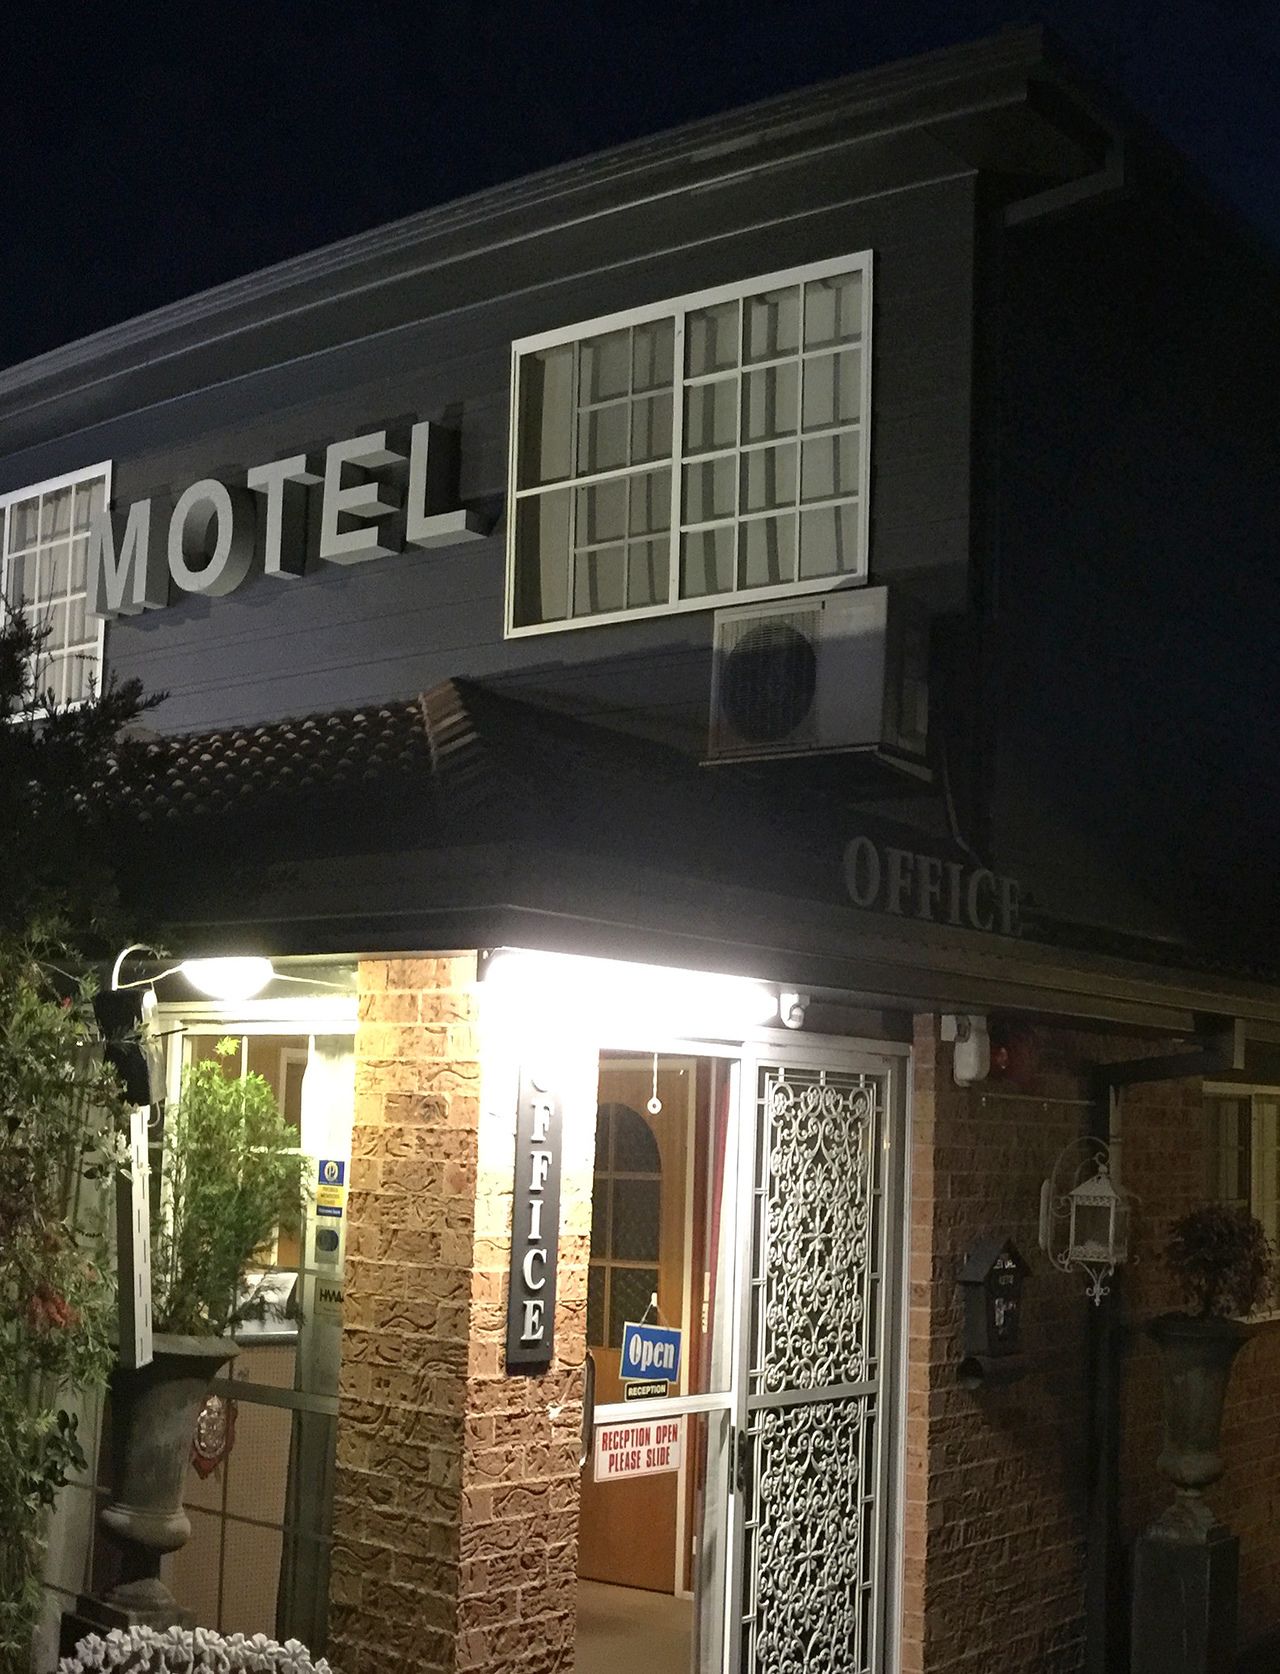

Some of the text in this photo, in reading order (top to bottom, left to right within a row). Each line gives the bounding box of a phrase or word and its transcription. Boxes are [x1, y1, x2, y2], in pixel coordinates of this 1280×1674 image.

[85, 420, 487, 620] MOTEL
[843, 835, 1022, 936] OFFICE
[520, 1076, 555, 1343] FFICE
[629, 1333, 675, 1372] Open
[628, 1384, 666, 1396] RECEPTION
[602, 1424, 678, 1451] RECEPTION OPEN
[609, 1446, 670, 1473] PLEASE SLIDE
